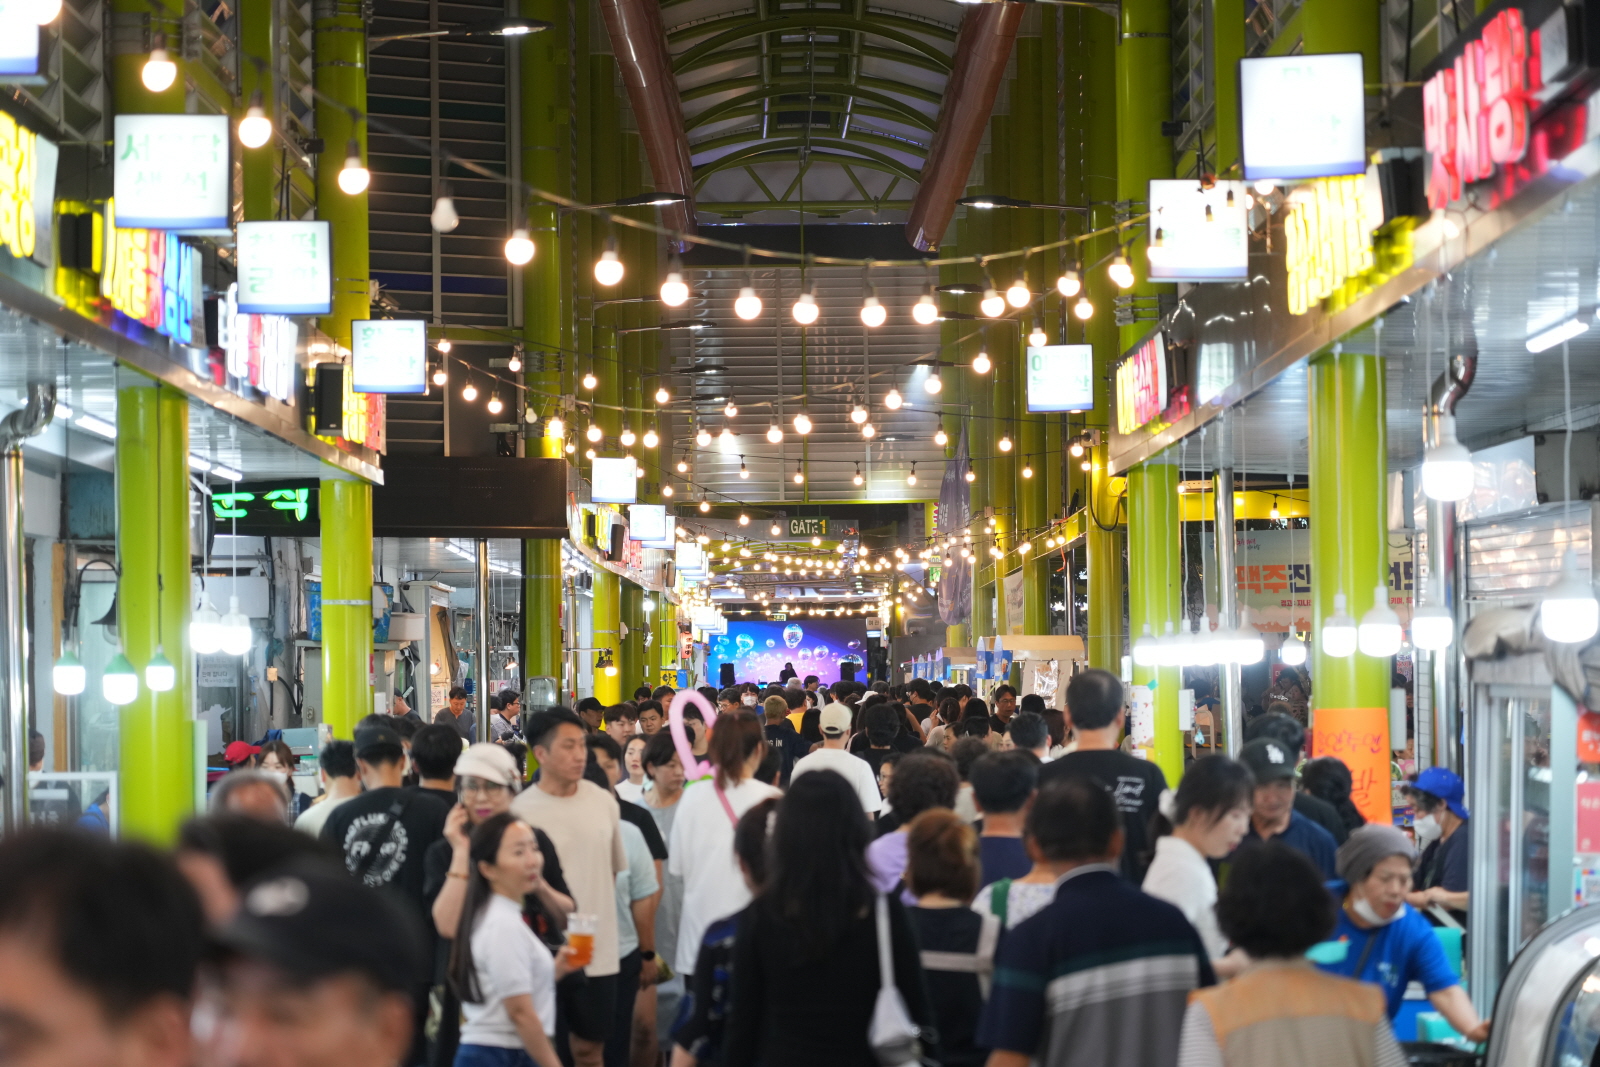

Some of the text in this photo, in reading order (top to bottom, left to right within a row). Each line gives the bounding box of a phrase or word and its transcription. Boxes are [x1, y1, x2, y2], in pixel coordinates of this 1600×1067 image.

[790, 519, 827, 535] GATE 1
[1351, 767, 1378, 808] 발
